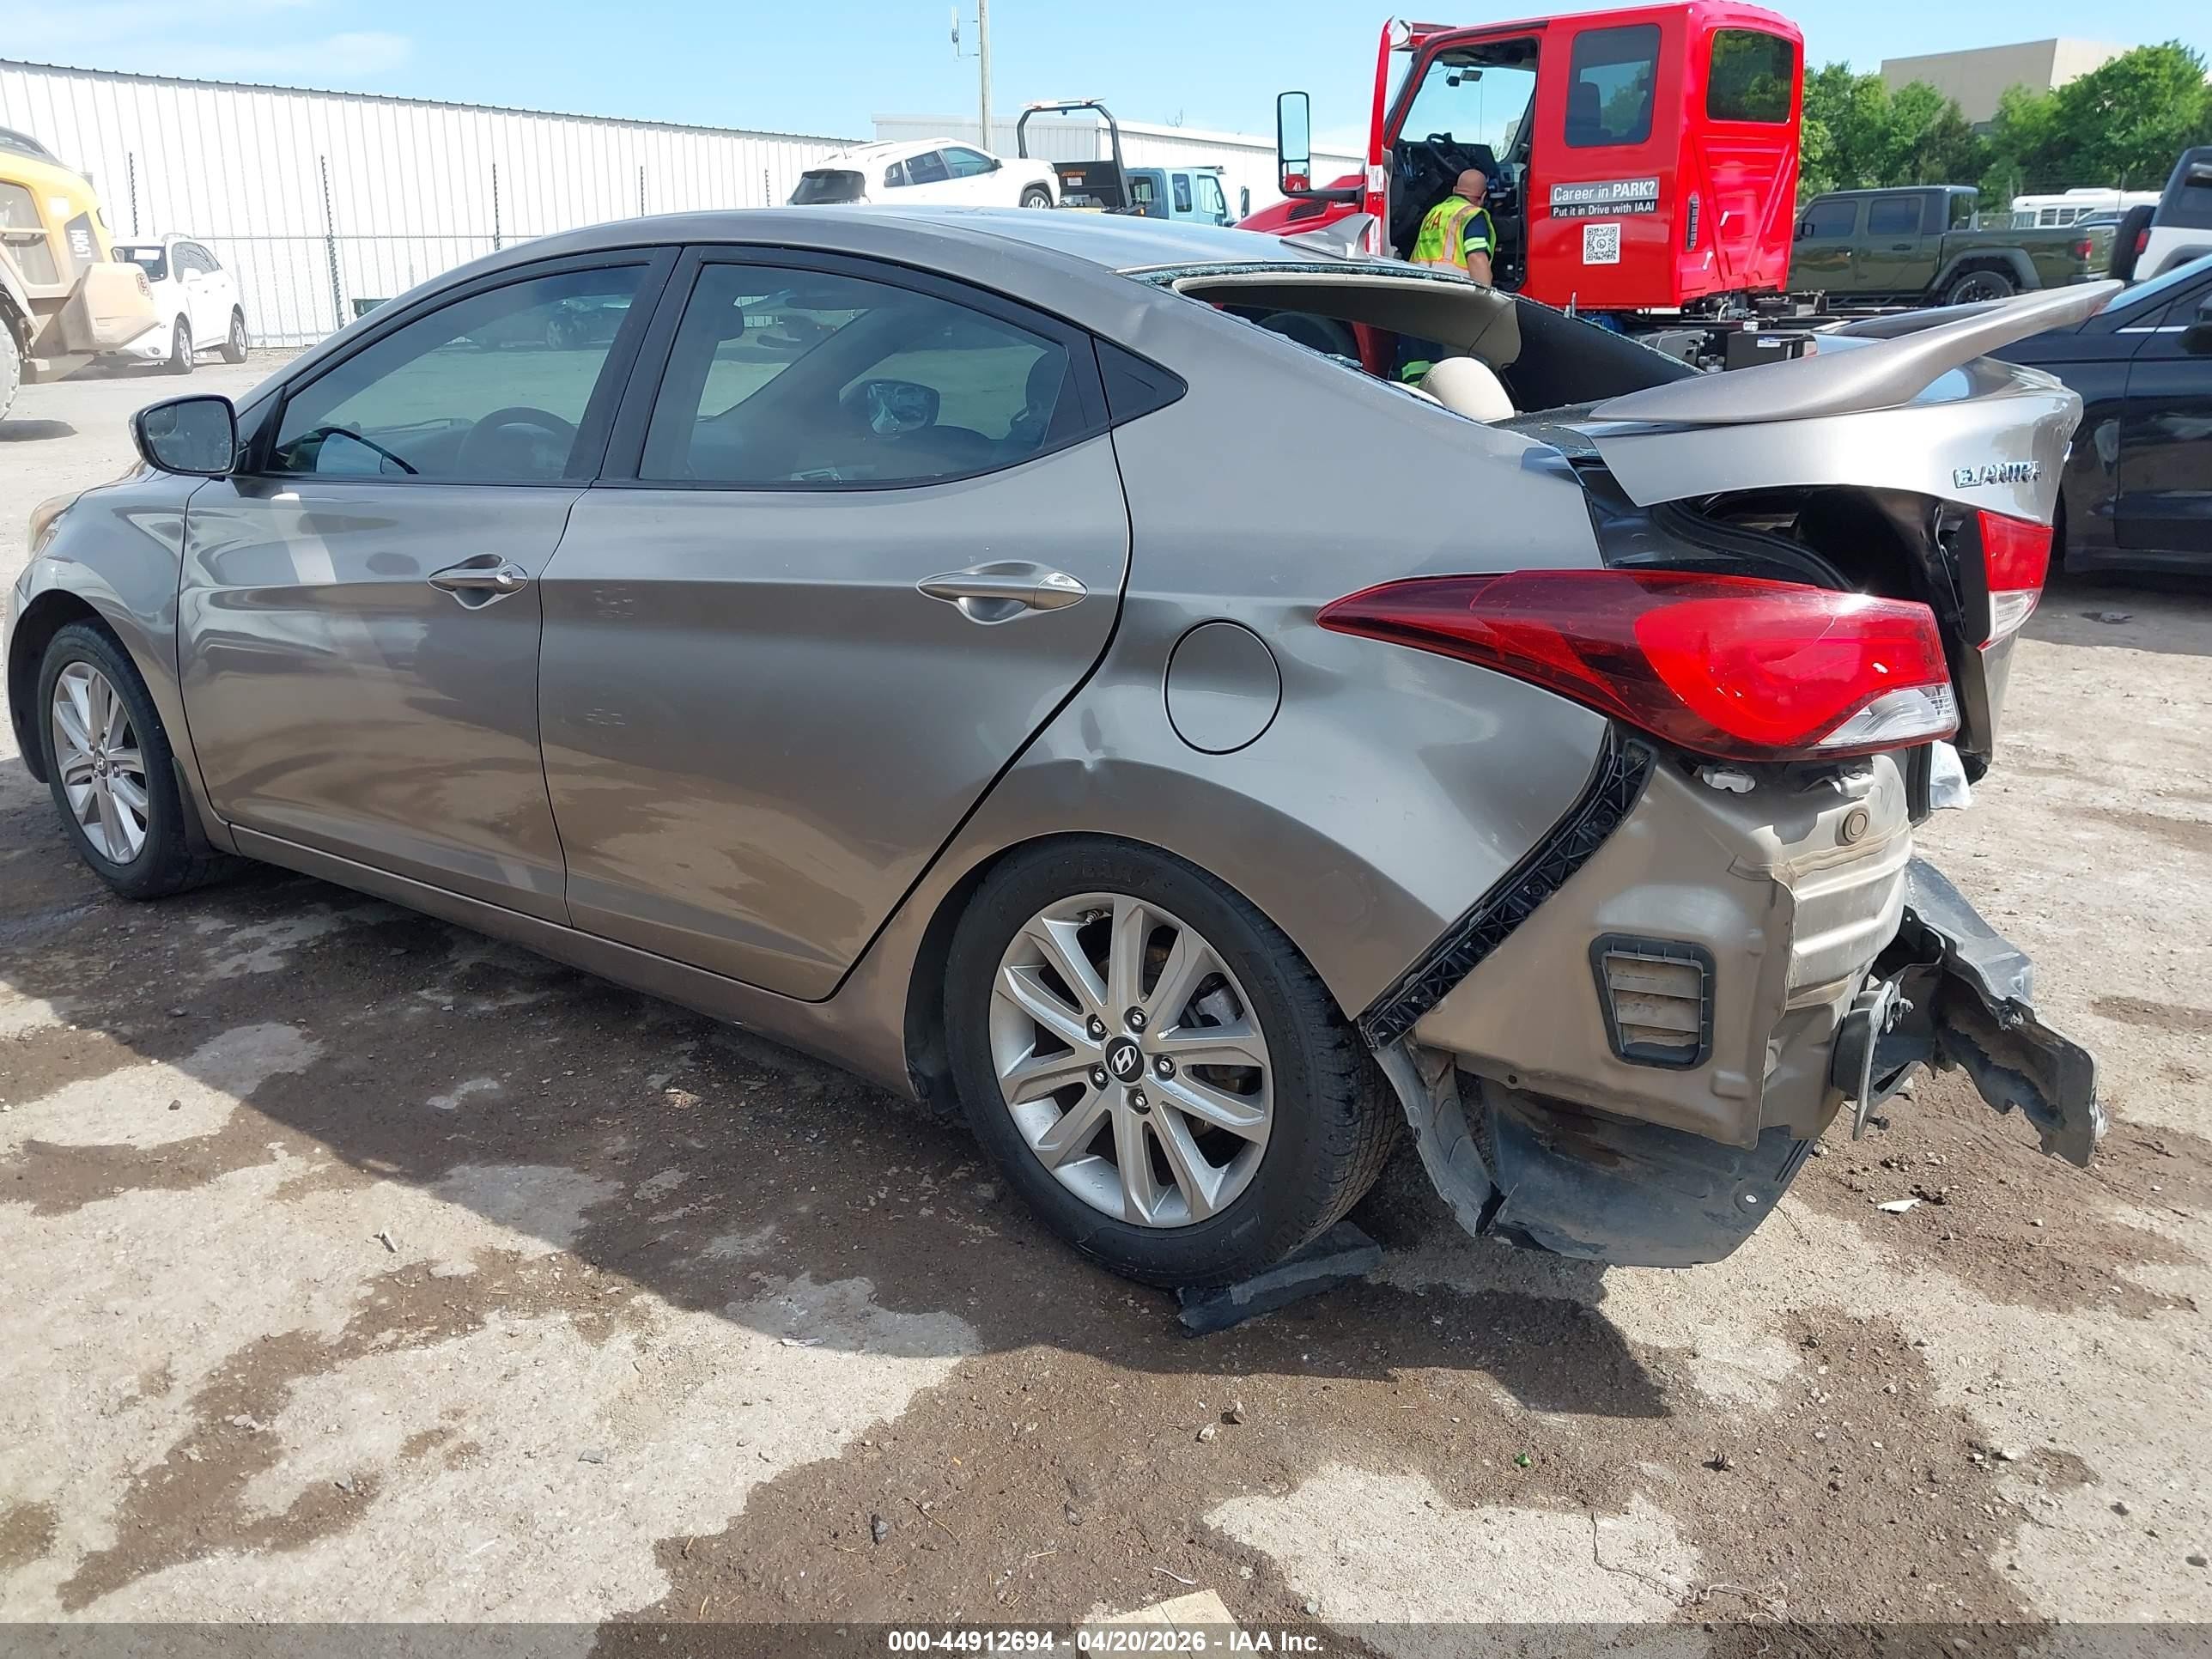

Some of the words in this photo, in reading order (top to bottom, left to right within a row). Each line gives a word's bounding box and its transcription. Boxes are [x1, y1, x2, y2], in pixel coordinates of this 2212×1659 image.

[1554, 187, 1594, 201] Career
[1598, 185, 1608, 198] in
[1613, 180, 1655, 198] PARK?
[1553, 207, 1567, 216] Put
[1570, 206, 1576, 216] it
[1578, 206, 1585, 216] in
[1589, 205, 1609, 215] Drive
[1613, 203, 1632, 214] with
[1634, 201, 1655, 213] IAAI
